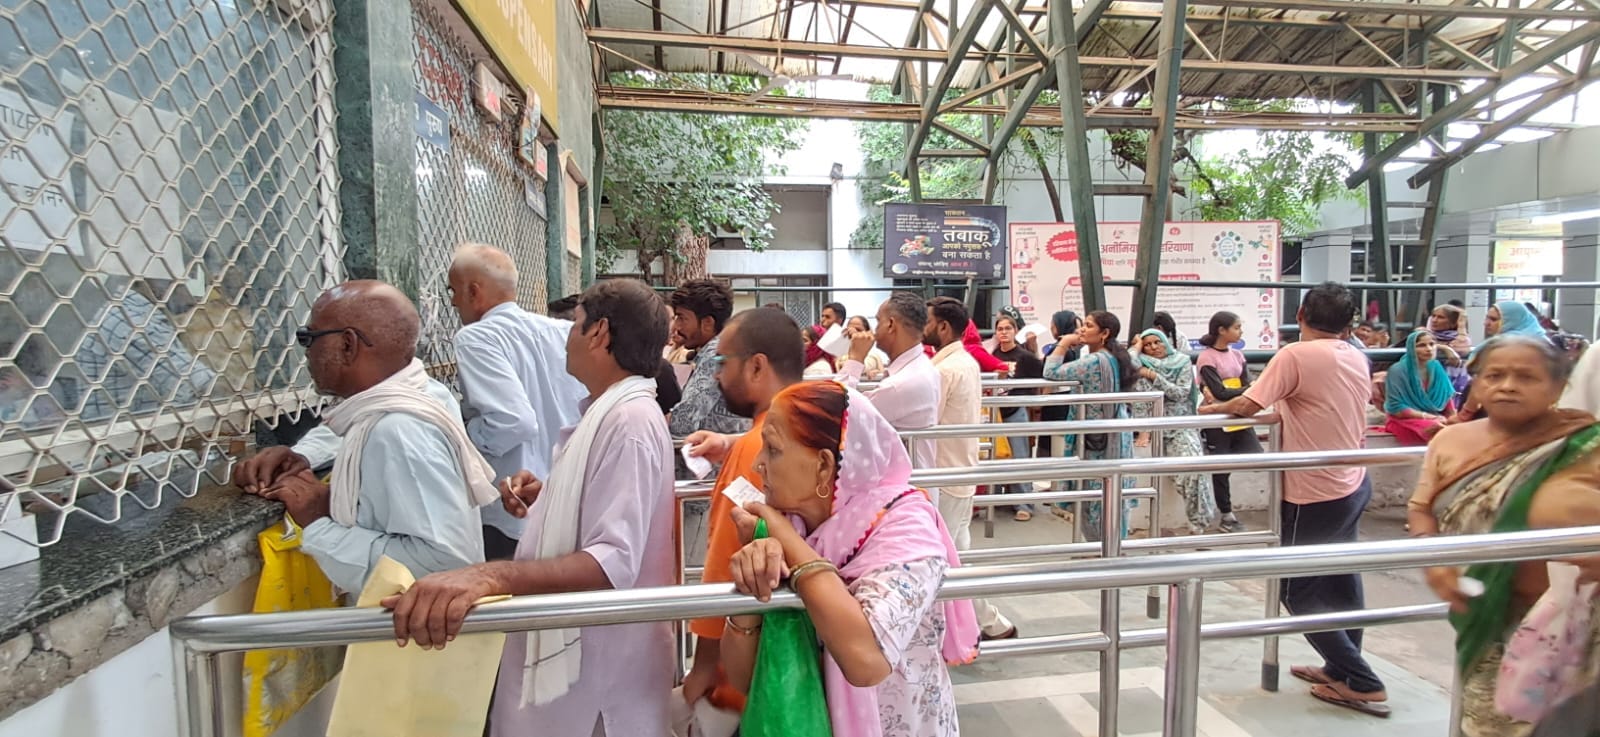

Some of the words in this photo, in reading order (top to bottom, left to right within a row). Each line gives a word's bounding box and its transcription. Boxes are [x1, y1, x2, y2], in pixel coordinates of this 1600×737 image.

[941, 226, 993, 248] तंबाकू
[942, 251, 956, 259] बना
[984, 250, 991, 260] है
